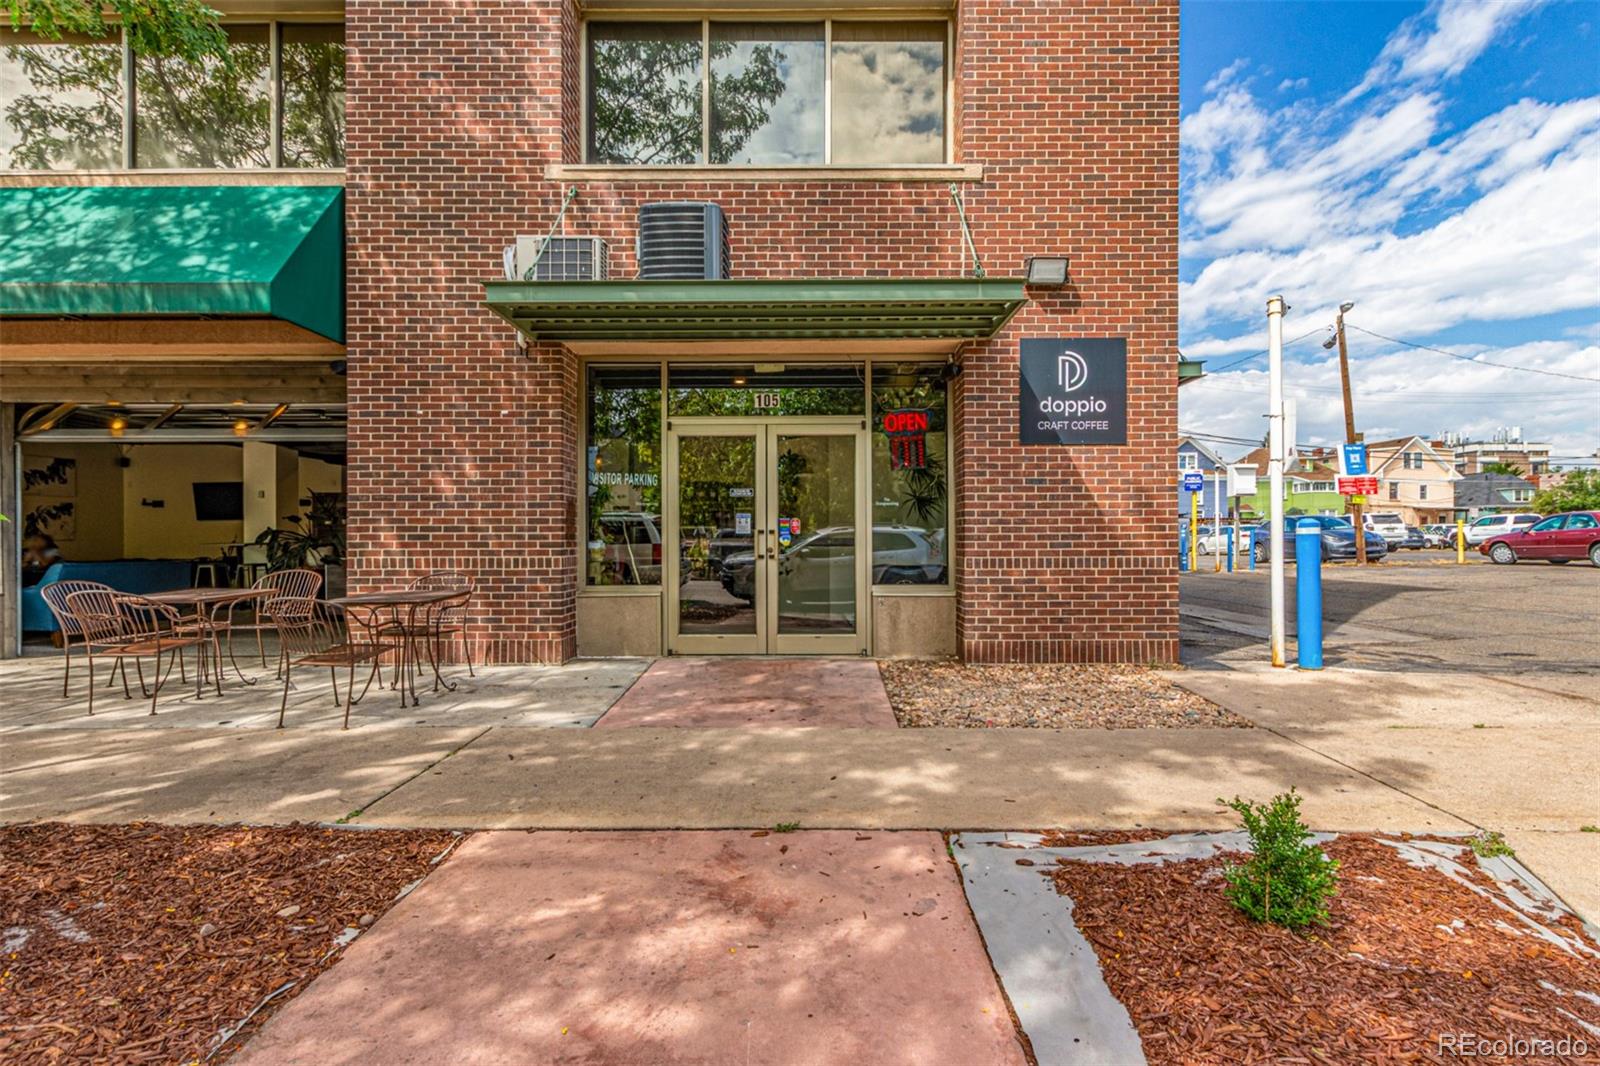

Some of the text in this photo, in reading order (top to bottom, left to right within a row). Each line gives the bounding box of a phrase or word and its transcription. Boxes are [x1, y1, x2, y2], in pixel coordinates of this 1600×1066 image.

[756, 394, 779, 407] 105
[1039, 396, 1107, 417] doppio
[883, 412, 928, 432] OPEN
[1037, 421, 1109, 430] CRAFT COFFEE
[624, 473, 658, 487] PARKING
